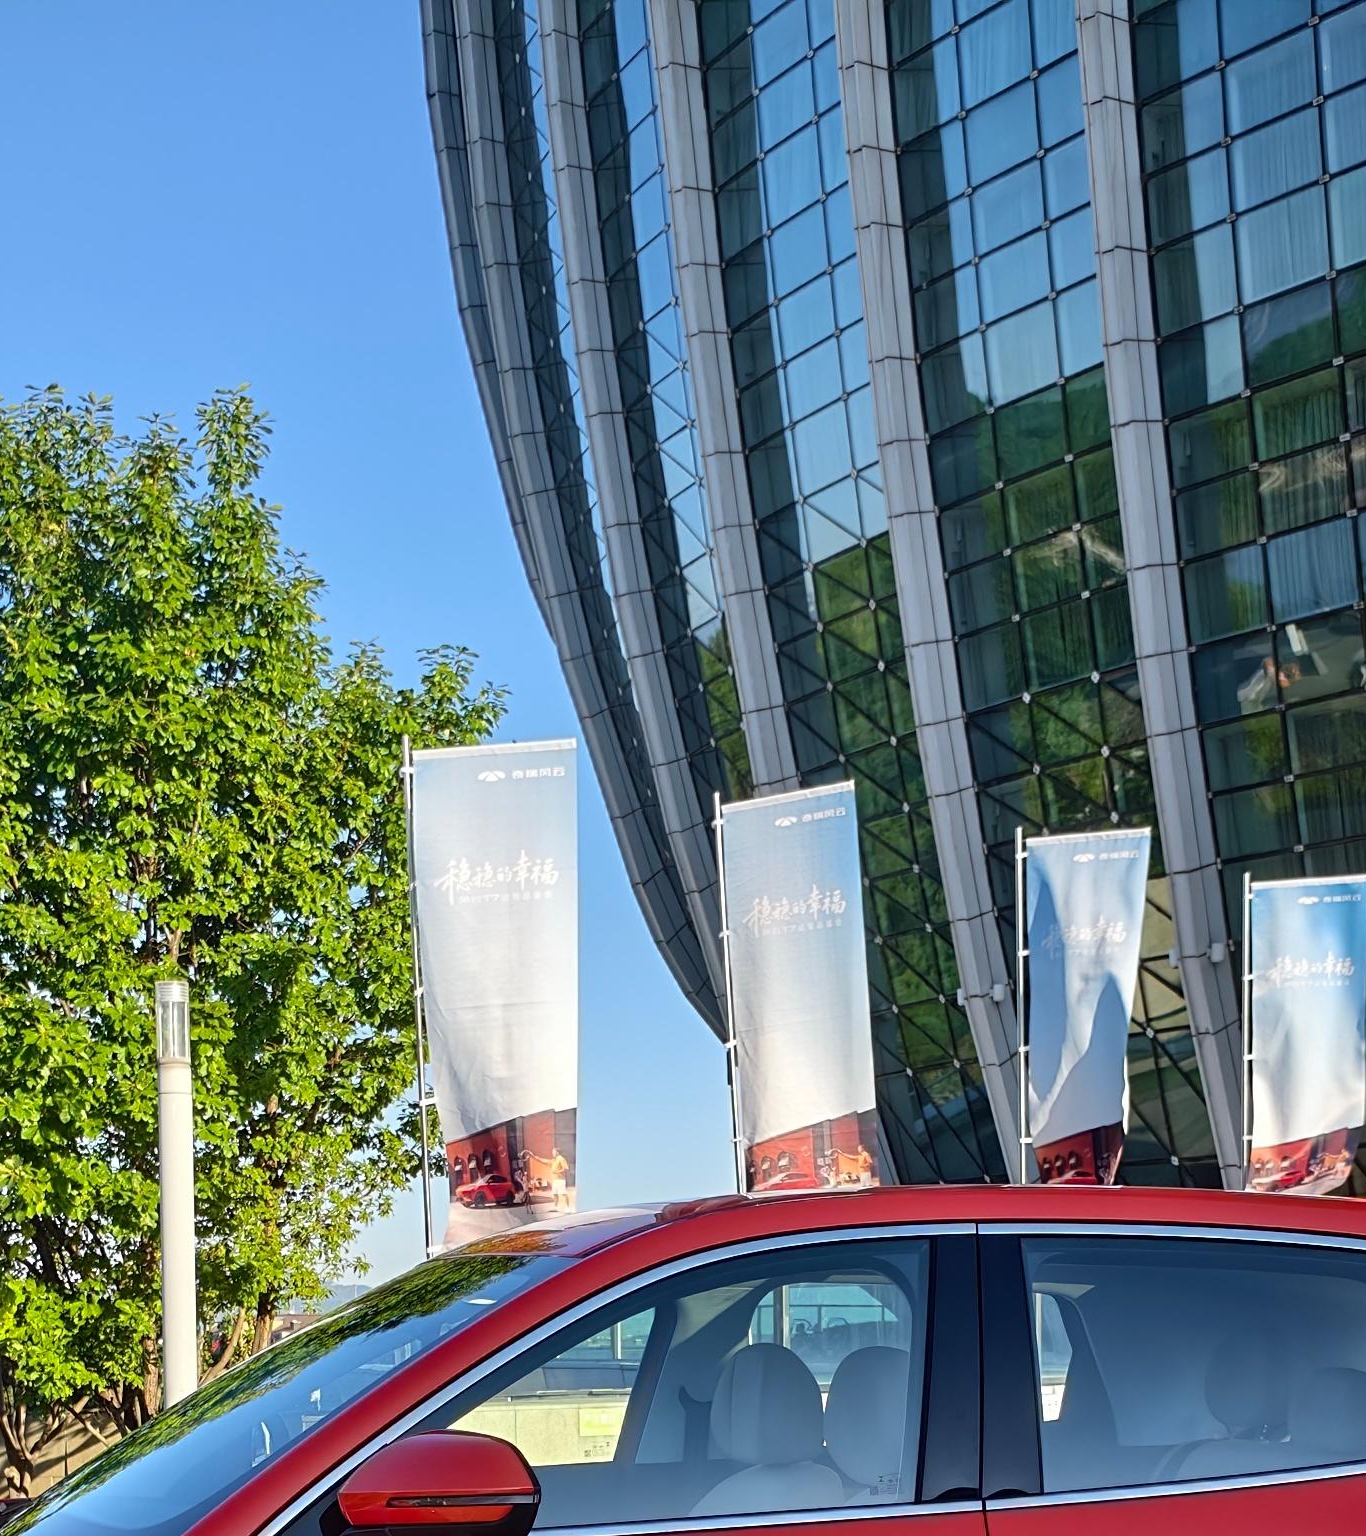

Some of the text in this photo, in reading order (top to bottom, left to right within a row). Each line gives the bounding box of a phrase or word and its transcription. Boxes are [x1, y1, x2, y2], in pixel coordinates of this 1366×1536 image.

[433, 849, 560, 906] 稳稳的幸福
[742, 884, 846, 938] 稳稳的幸福
